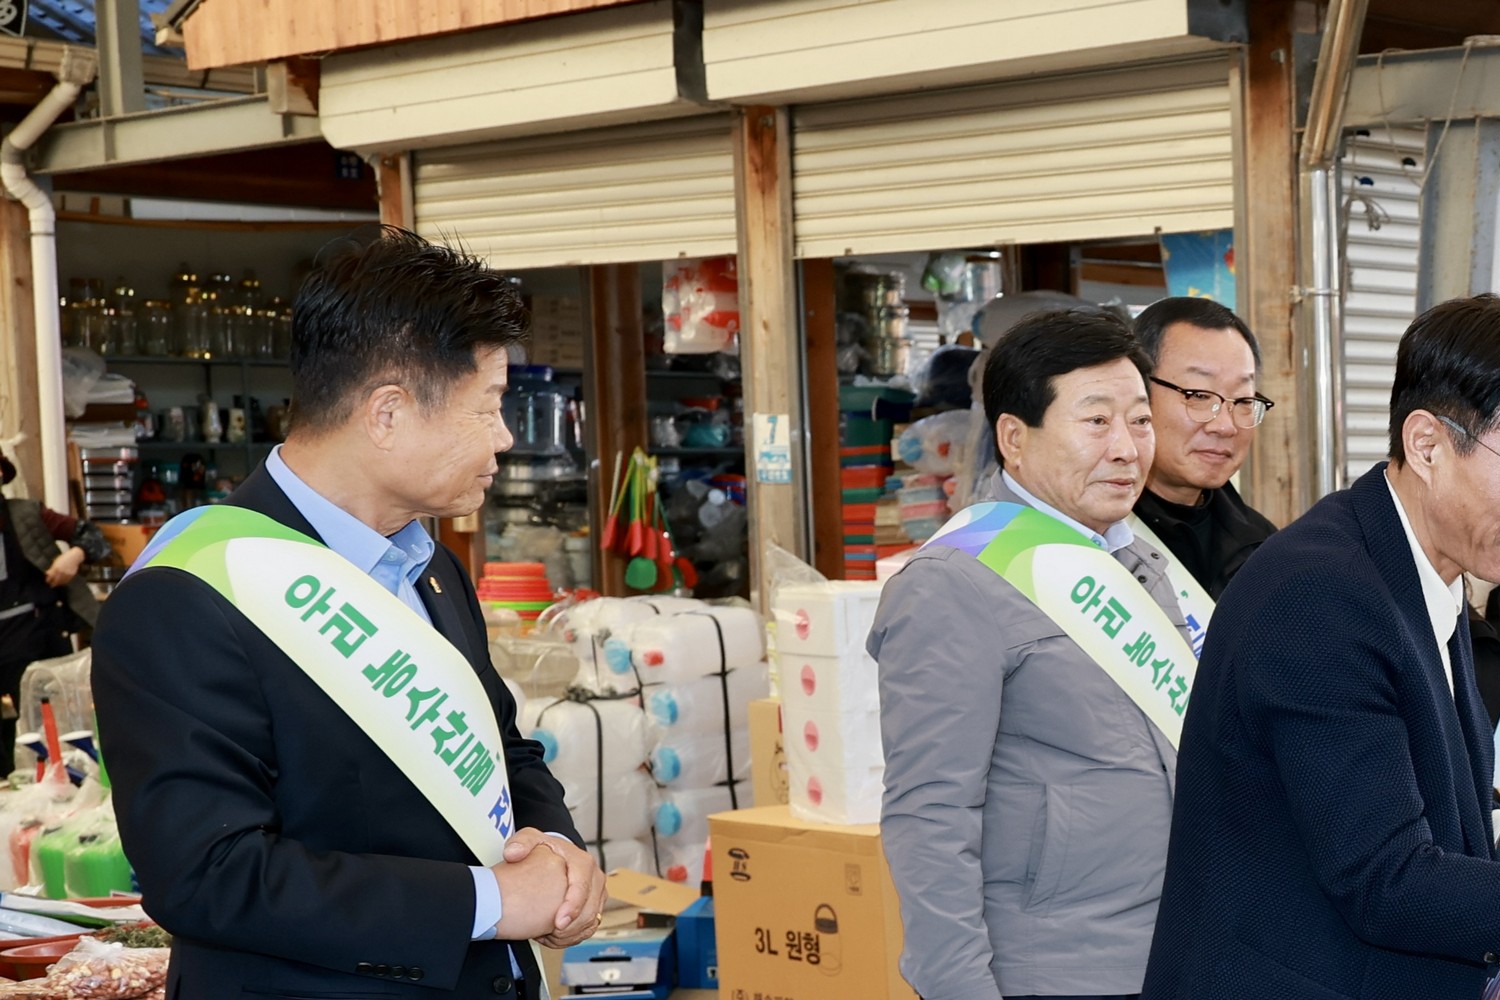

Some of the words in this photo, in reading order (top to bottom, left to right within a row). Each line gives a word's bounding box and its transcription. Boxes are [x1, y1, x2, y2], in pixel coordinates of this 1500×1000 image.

[284, 574, 380, 659] 우리
[1070, 575, 1133, 640] 우리
[1121, 631, 1193, 717] 농수산
[754, 926, 779, 956] 3L
[785, 929, 822, 966] 원형
